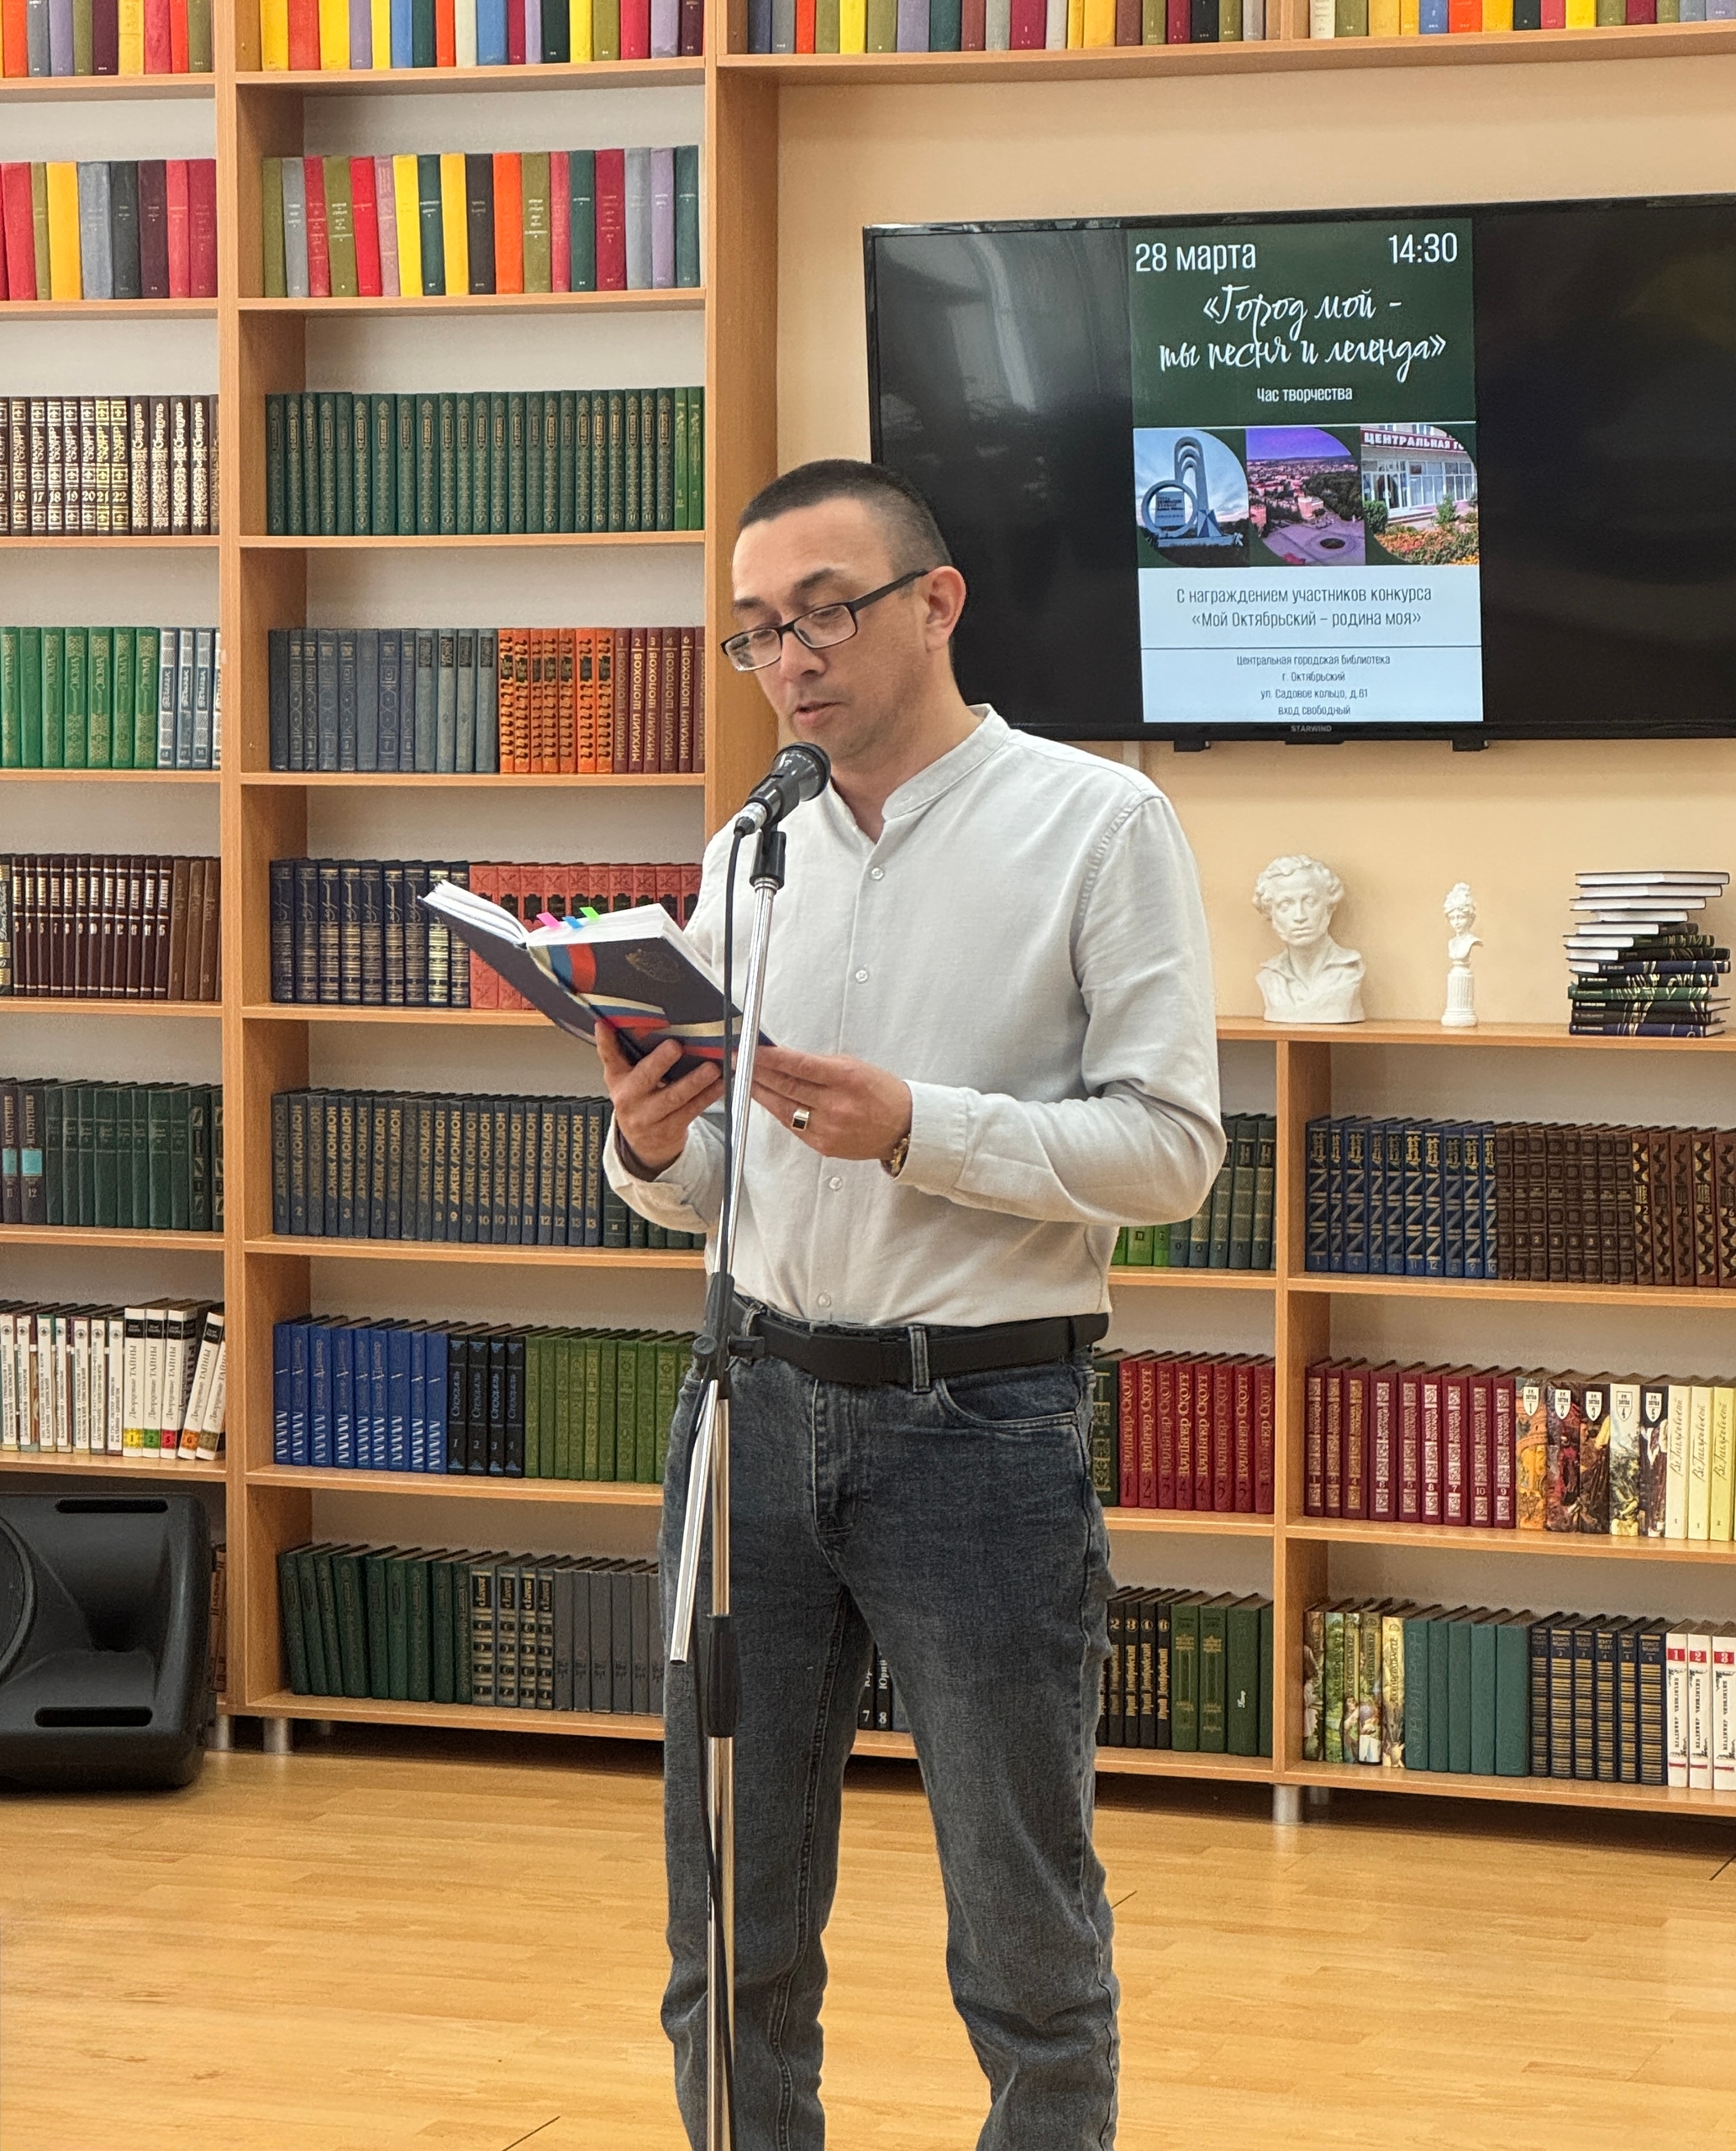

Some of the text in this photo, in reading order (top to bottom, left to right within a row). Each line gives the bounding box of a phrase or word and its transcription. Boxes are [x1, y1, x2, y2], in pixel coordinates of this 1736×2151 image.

[1389, 233, 1458, 265] 14:30
[1135, 243, 1256, 275] 28 марта
[1202, 284, 1307, 341] «Город
[1314, 289, 1376, 320] мой
[1160, 334, 1447, 383] ты песня и легенда»
[1257, 387, 1353, 404] Час творчества
[1364, 432, 1451, 450] ЦЕНТРАЛЬНАЯ
[13, 490, 26, 502] 16
[33, 490, 45, 502] 17
[49, 490, 62, 502] 18
[66, 490, 78, 502] 19
[82, 490, 96, 502] 20
[97, 490, 109, 502] 21
[112, 490, 127, 502] 22
[1176, 586, 1432, 605] С награждением участников конкурса
[1192, 611, 1228, 628] «Мой
[1232, 610, 1317, 628] Октябрьский
[1332, 613, 1381, 628] родина
[1385, 612, 1422, 627] моя»
[635, 638, 640, 647] 2
[650, 637, 656, 646] 3
[667, 637, 672, 645] 4
[1237, 655, 1391, 666] Центральная городская библиотека
[1291, 671, 1345, 682] Октябрьский
[1260, 689, 1272, 700] ул.
[1276, 688, 1313, 700] Садовое
[1314, 688, 1347, 700] кольцо,
[632, 653, 642, 762] МИХАИЛ ШОЛОХОВ
[647, 652, 657, 760] МИХАИЛ ШОЛОХОВ
[664, 652, 674, 760] МИХАИЛ ШОЛОХОВ
[681, 650, 691, 759] МИХАИЛ ШОЛОХОВ
[1278, 705, 1350, 716] вход свободный
[292, 1105, 302, 1198] ДЖЕК ЛОНДОН
[341, 1107, 351, 1200] ДЖЕК ЛОНДОН
[434, 1111, 445, 1204] ДЖЕК ЛОНДОН
[450, 1111, 460, 1205] ДЖЕК ЛОНДОН
[480, 1113, 491, 1208] ДЖЕК ЛОНДОН
[542, 1113, 553, 1207] ДЖЕК ЛОНДОН
[295, 1207, 302, 1216] 2
[344, 1208, 351, 1218] 3
[435, 1212, 442, 1222] 8
[450, 1212, 458, 1221] 9
[479, 1215, 490, 1225] 10
[540, 1216, 551, 1225] 12
[453, 1438, 458, 1447] 1
[473, 1440, 479, 1449] 2
[491, 1442, 497, 1450] 3
[1476, 1487, 1486, 1496] 10
[1674, 1650, 1679, 1660] 1
[1695, 1651, 1702, 1661] 2
[1721, 1653, 1728, 1663] 3
[862, 1709, 871, 1722] 7
[879, 1712, 887, 1724] 8
